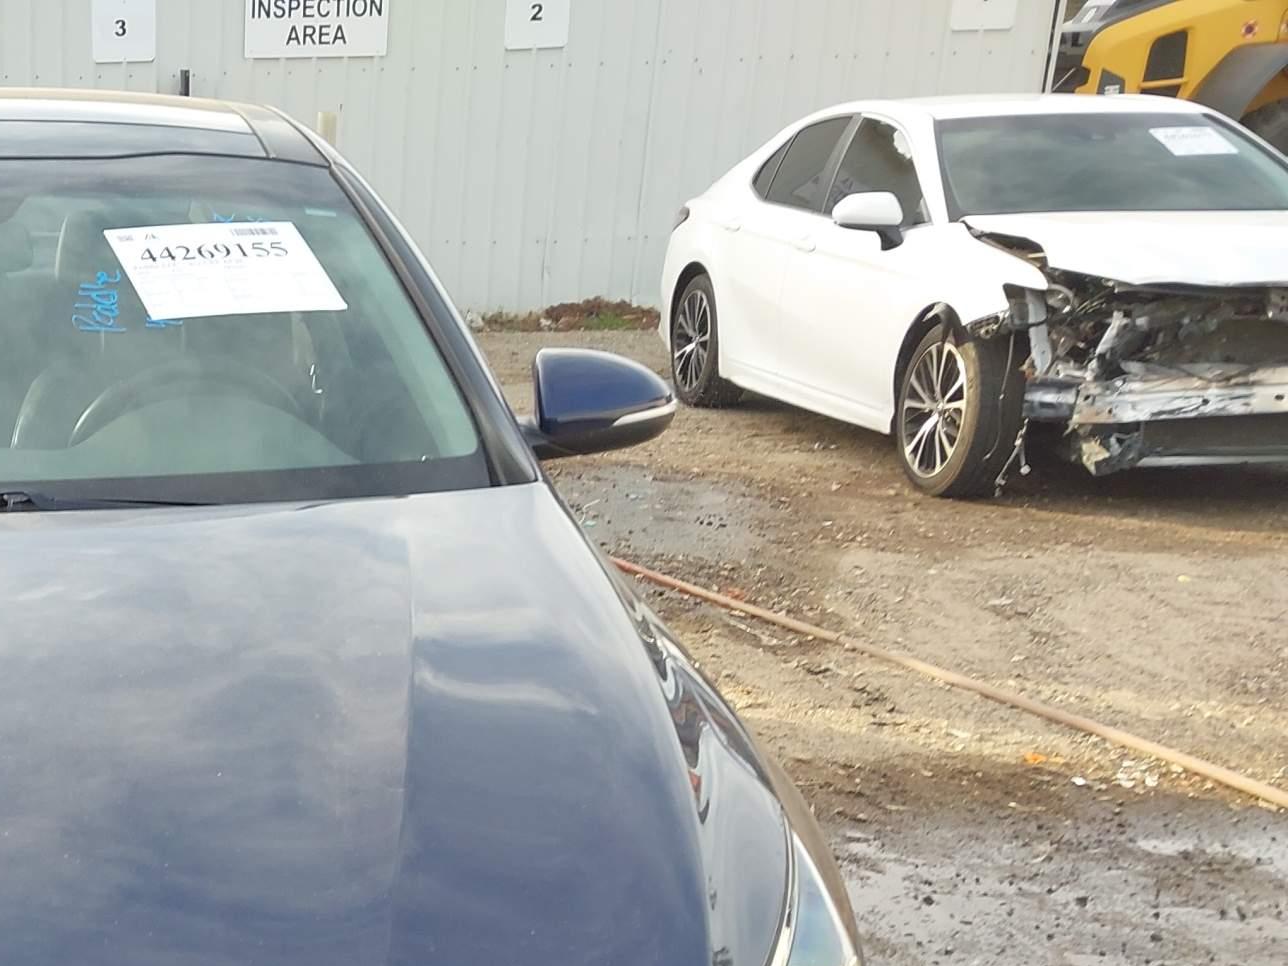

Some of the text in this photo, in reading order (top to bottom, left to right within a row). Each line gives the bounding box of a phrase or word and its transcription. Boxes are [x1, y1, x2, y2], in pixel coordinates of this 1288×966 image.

[251, 0, 383, 19] INSPECTION
[530, 3, 543, 21] 2
[114, 19, 127, 37] 3
[286, 24, 347, 46] AREA
[140, 241, 289, 263] 44269155
